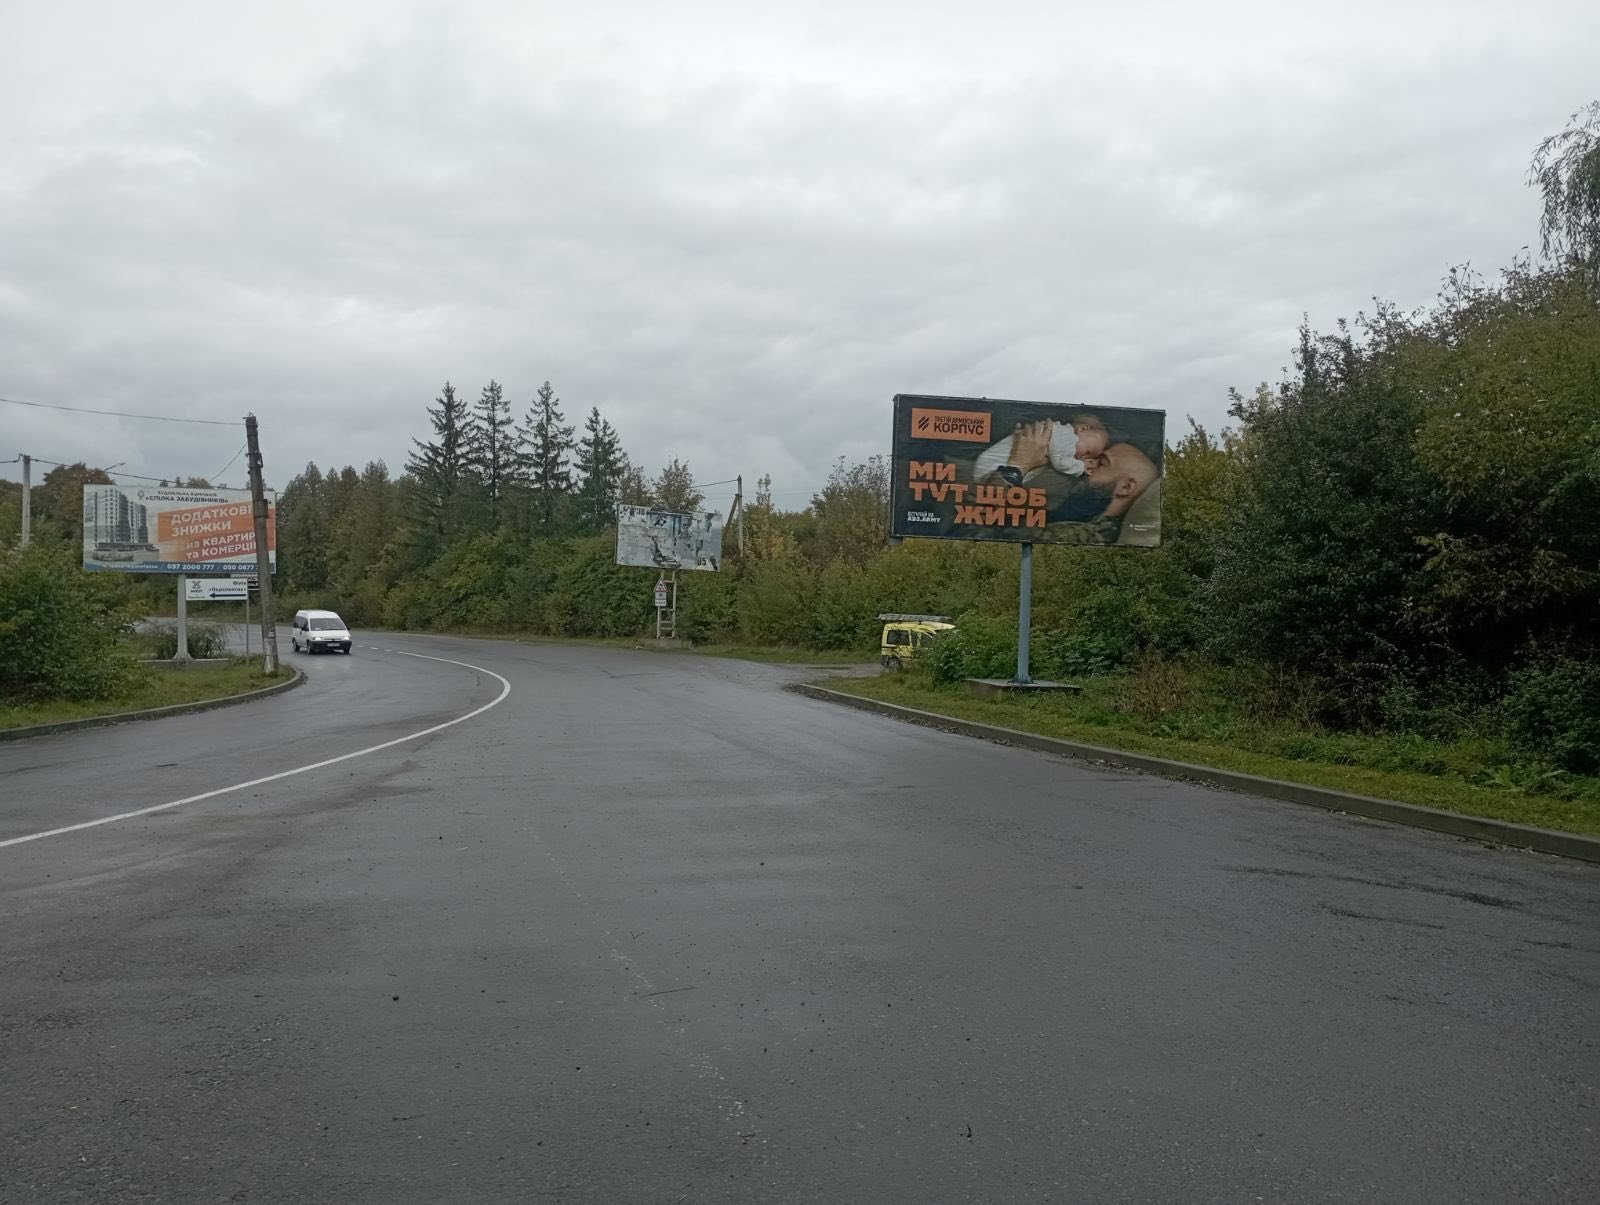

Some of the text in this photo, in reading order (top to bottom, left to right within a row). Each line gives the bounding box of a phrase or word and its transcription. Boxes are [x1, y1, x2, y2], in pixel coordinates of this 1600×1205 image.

[934, 422, 984, 435] КОРПУС
[909, 460, 956, 481] МИ
[909, 481, 1047, 507] ТУТ ЩОБ
[954, 505, 1046, 528] ЖИТИ
[171, 520, 231, 537] ЗНИЖКИ
[186, 532, 256, 550] на КВАРТИР
[186, 551, 199, 559] та
